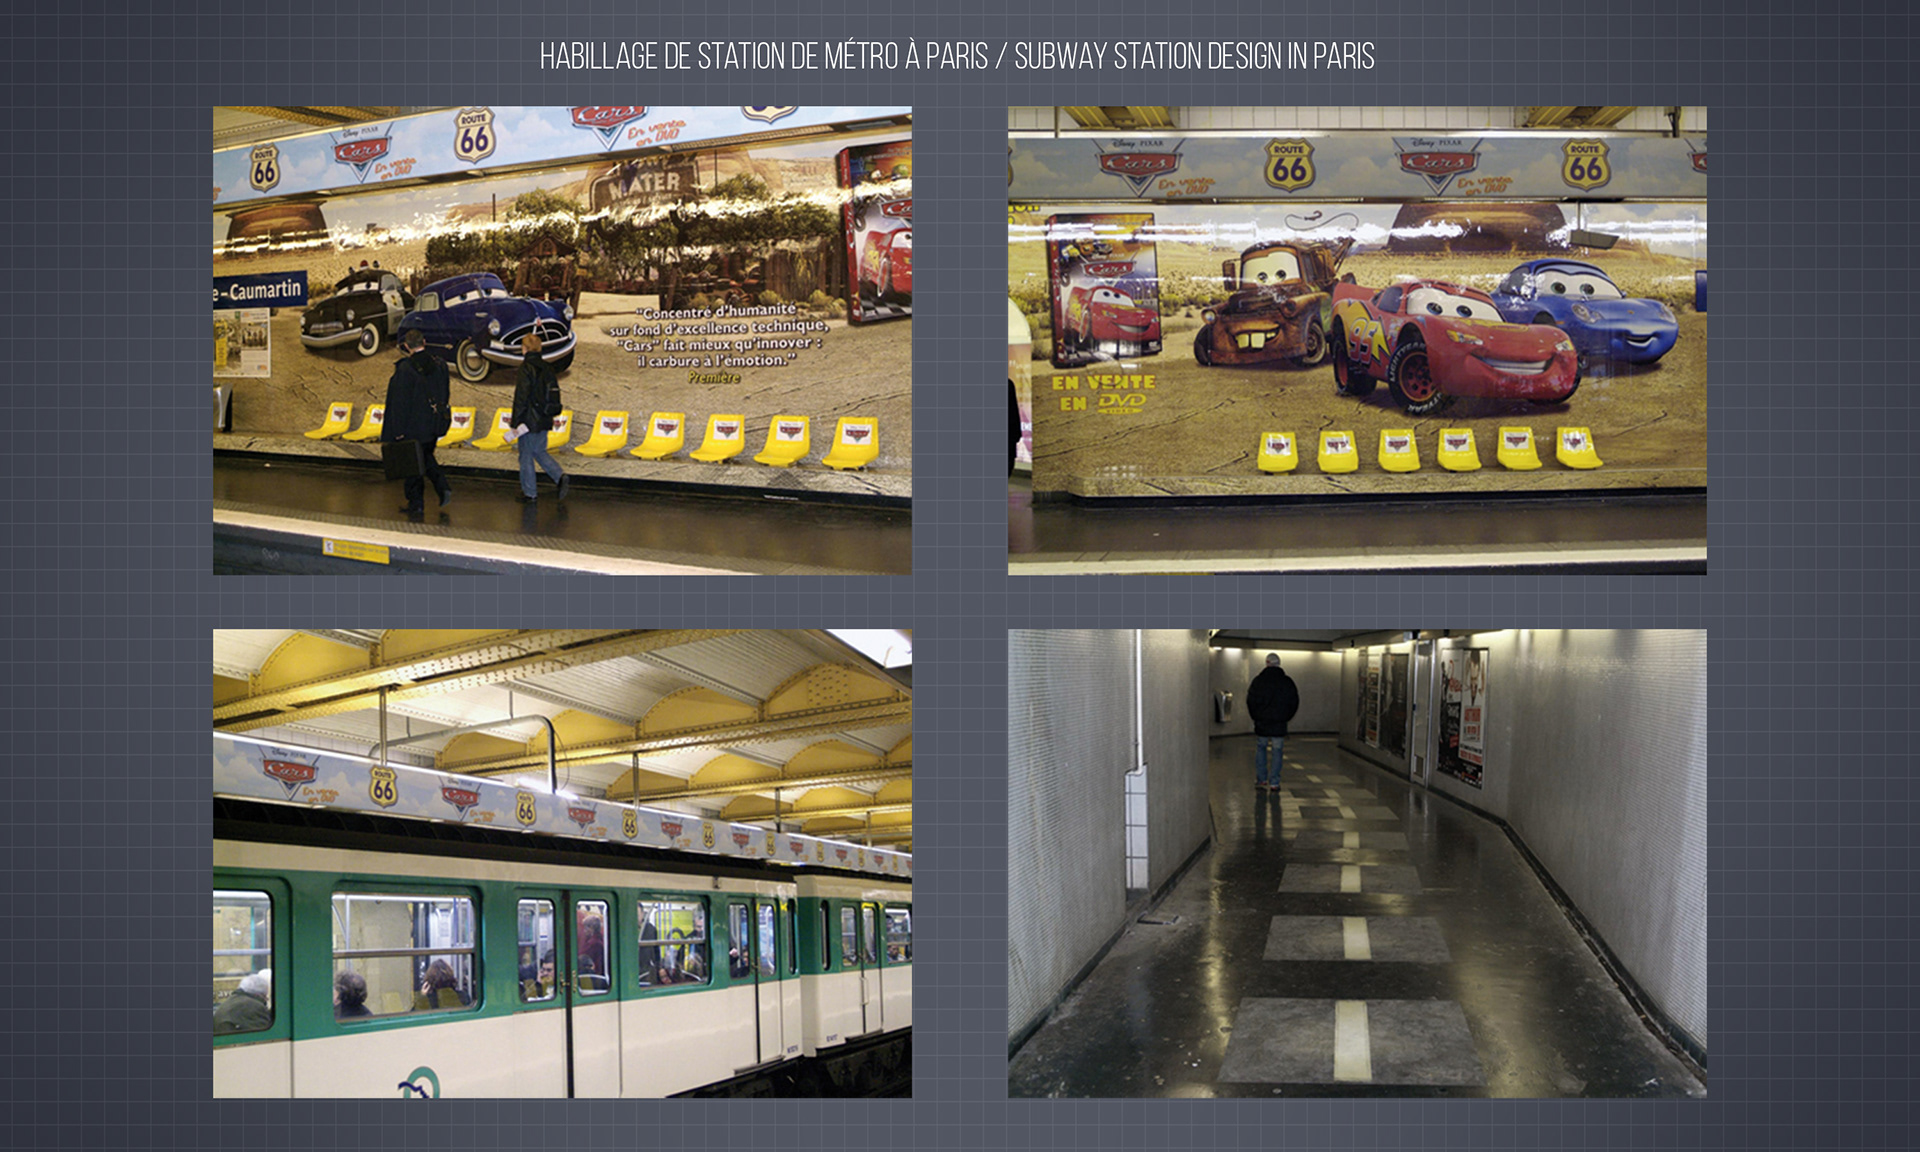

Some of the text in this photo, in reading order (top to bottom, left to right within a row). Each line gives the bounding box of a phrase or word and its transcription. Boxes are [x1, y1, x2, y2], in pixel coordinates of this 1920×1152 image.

[462, 113, 486, 124] ROUTE
[461, 126, 489, 153] 66
[255, 149, 273, 159] ROUTE
[340, 144, 382, 158] Cars
[1274, 145, 1303, 153] ROUTE
[1571, 145, 1599, 153] ROUTE
[1107, 155, 1168, 169] Cars
[1273, 157, 1306, 181] 66
[1407, 154, 1467, 168] Cars
[1570, 157, 1602, 180] 66
[255, 160, 275, 184] 66
[716, 302, 796, 318] d'humanité
[610, 319, 829, 337] sur fond d'excellence technique,
[664, 339, 684, 351] fait
[689, 339, 730, 351] mieux
[735, 337, 812, 353] qu'innover
[1350, 318, 1377, 365] 95
[638, 355, 645, 368] il
[649, 355, 700, 367] carbure
[704, 354, 712, 367] à
[688, 370, 741, 383] Première
[1052, 374, 1156, 390] EN VENTE
[1060, 393, 1146, 411] EN DVD
[268, 763, 309, 778] Cars
[374, 780, 393, 800] 66
[519, 803, 533, 820] 66
